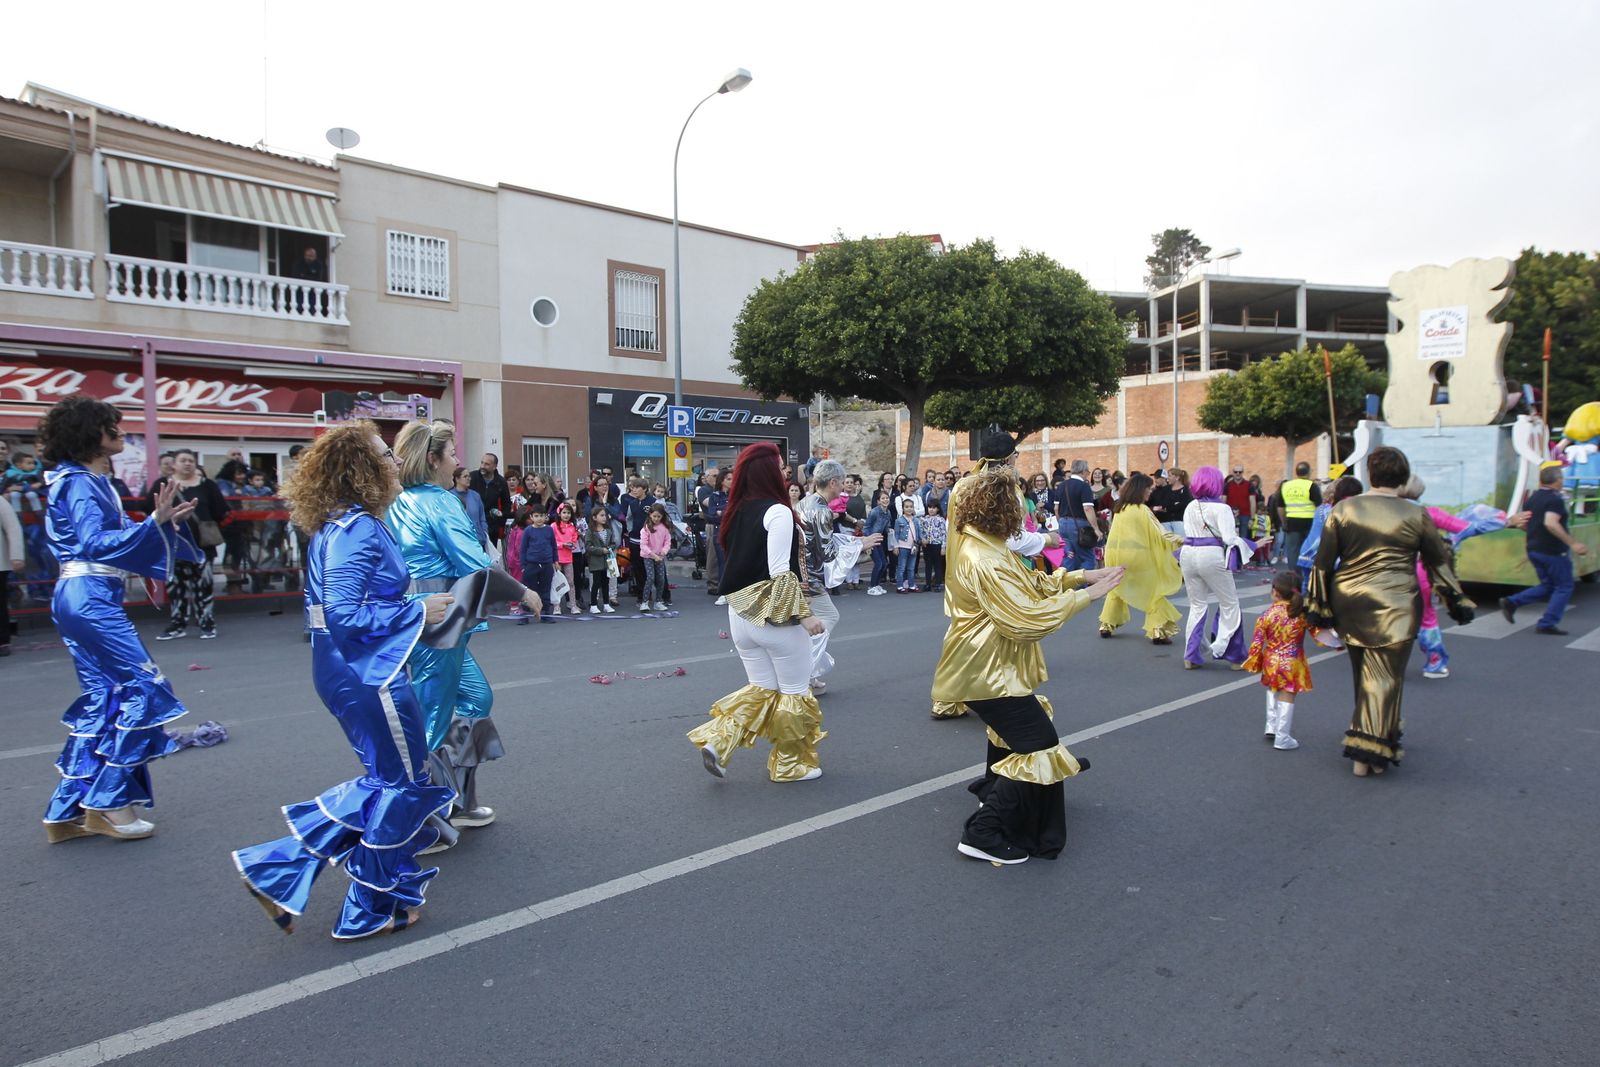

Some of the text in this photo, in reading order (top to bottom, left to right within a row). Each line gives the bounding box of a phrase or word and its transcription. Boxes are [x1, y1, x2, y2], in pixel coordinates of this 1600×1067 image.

[1424, 326, 1461, 338] Conde
[673, 409, 690, 434] P
[750, 414, 788, 426] BIKE
